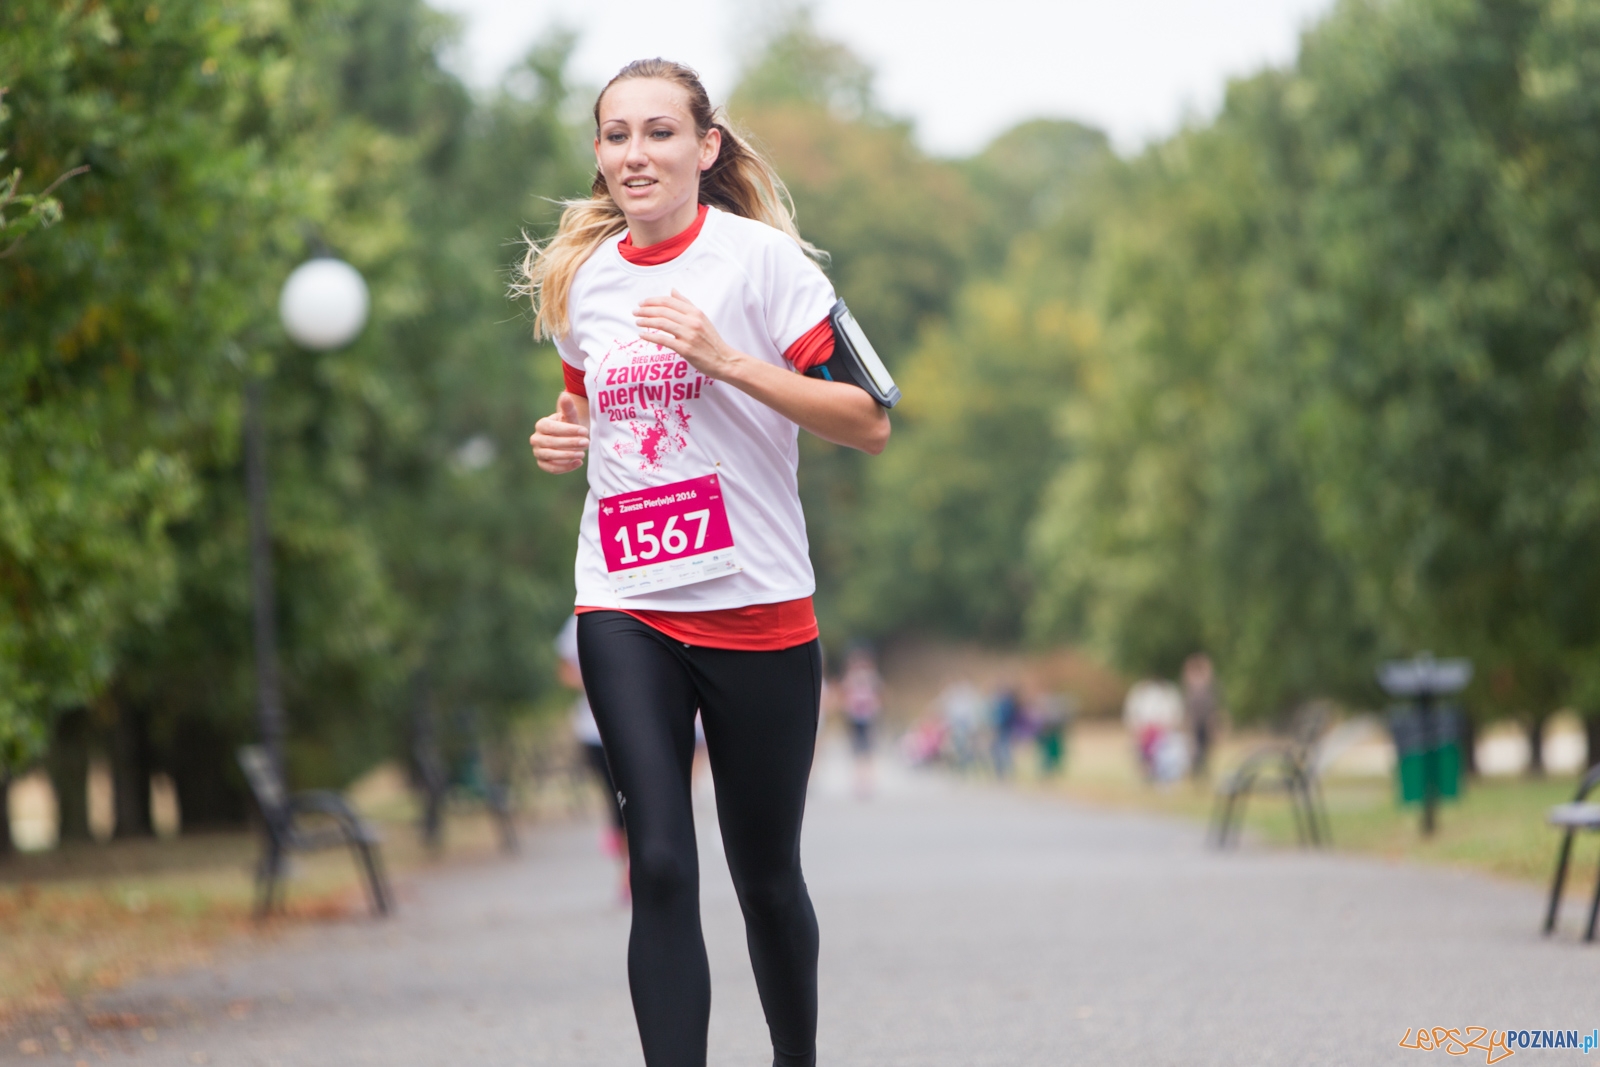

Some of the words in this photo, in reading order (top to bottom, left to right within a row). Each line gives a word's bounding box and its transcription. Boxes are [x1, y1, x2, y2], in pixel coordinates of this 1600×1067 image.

[631, 355, 649, 364] BIEG
[649, 352, 677, 363] KOBIET
[606, 360, 688, 386] zawsze
[598, 376, 702, 413] pier(w)si!
[607, 406, 637, 422] 2016
[619, 502, 644, 513] Zawsze
[643, 494, 676, 509] Pier(w)si
[675, 490, 697, 503] 2016
[614, 508, 711, 565] 1567
